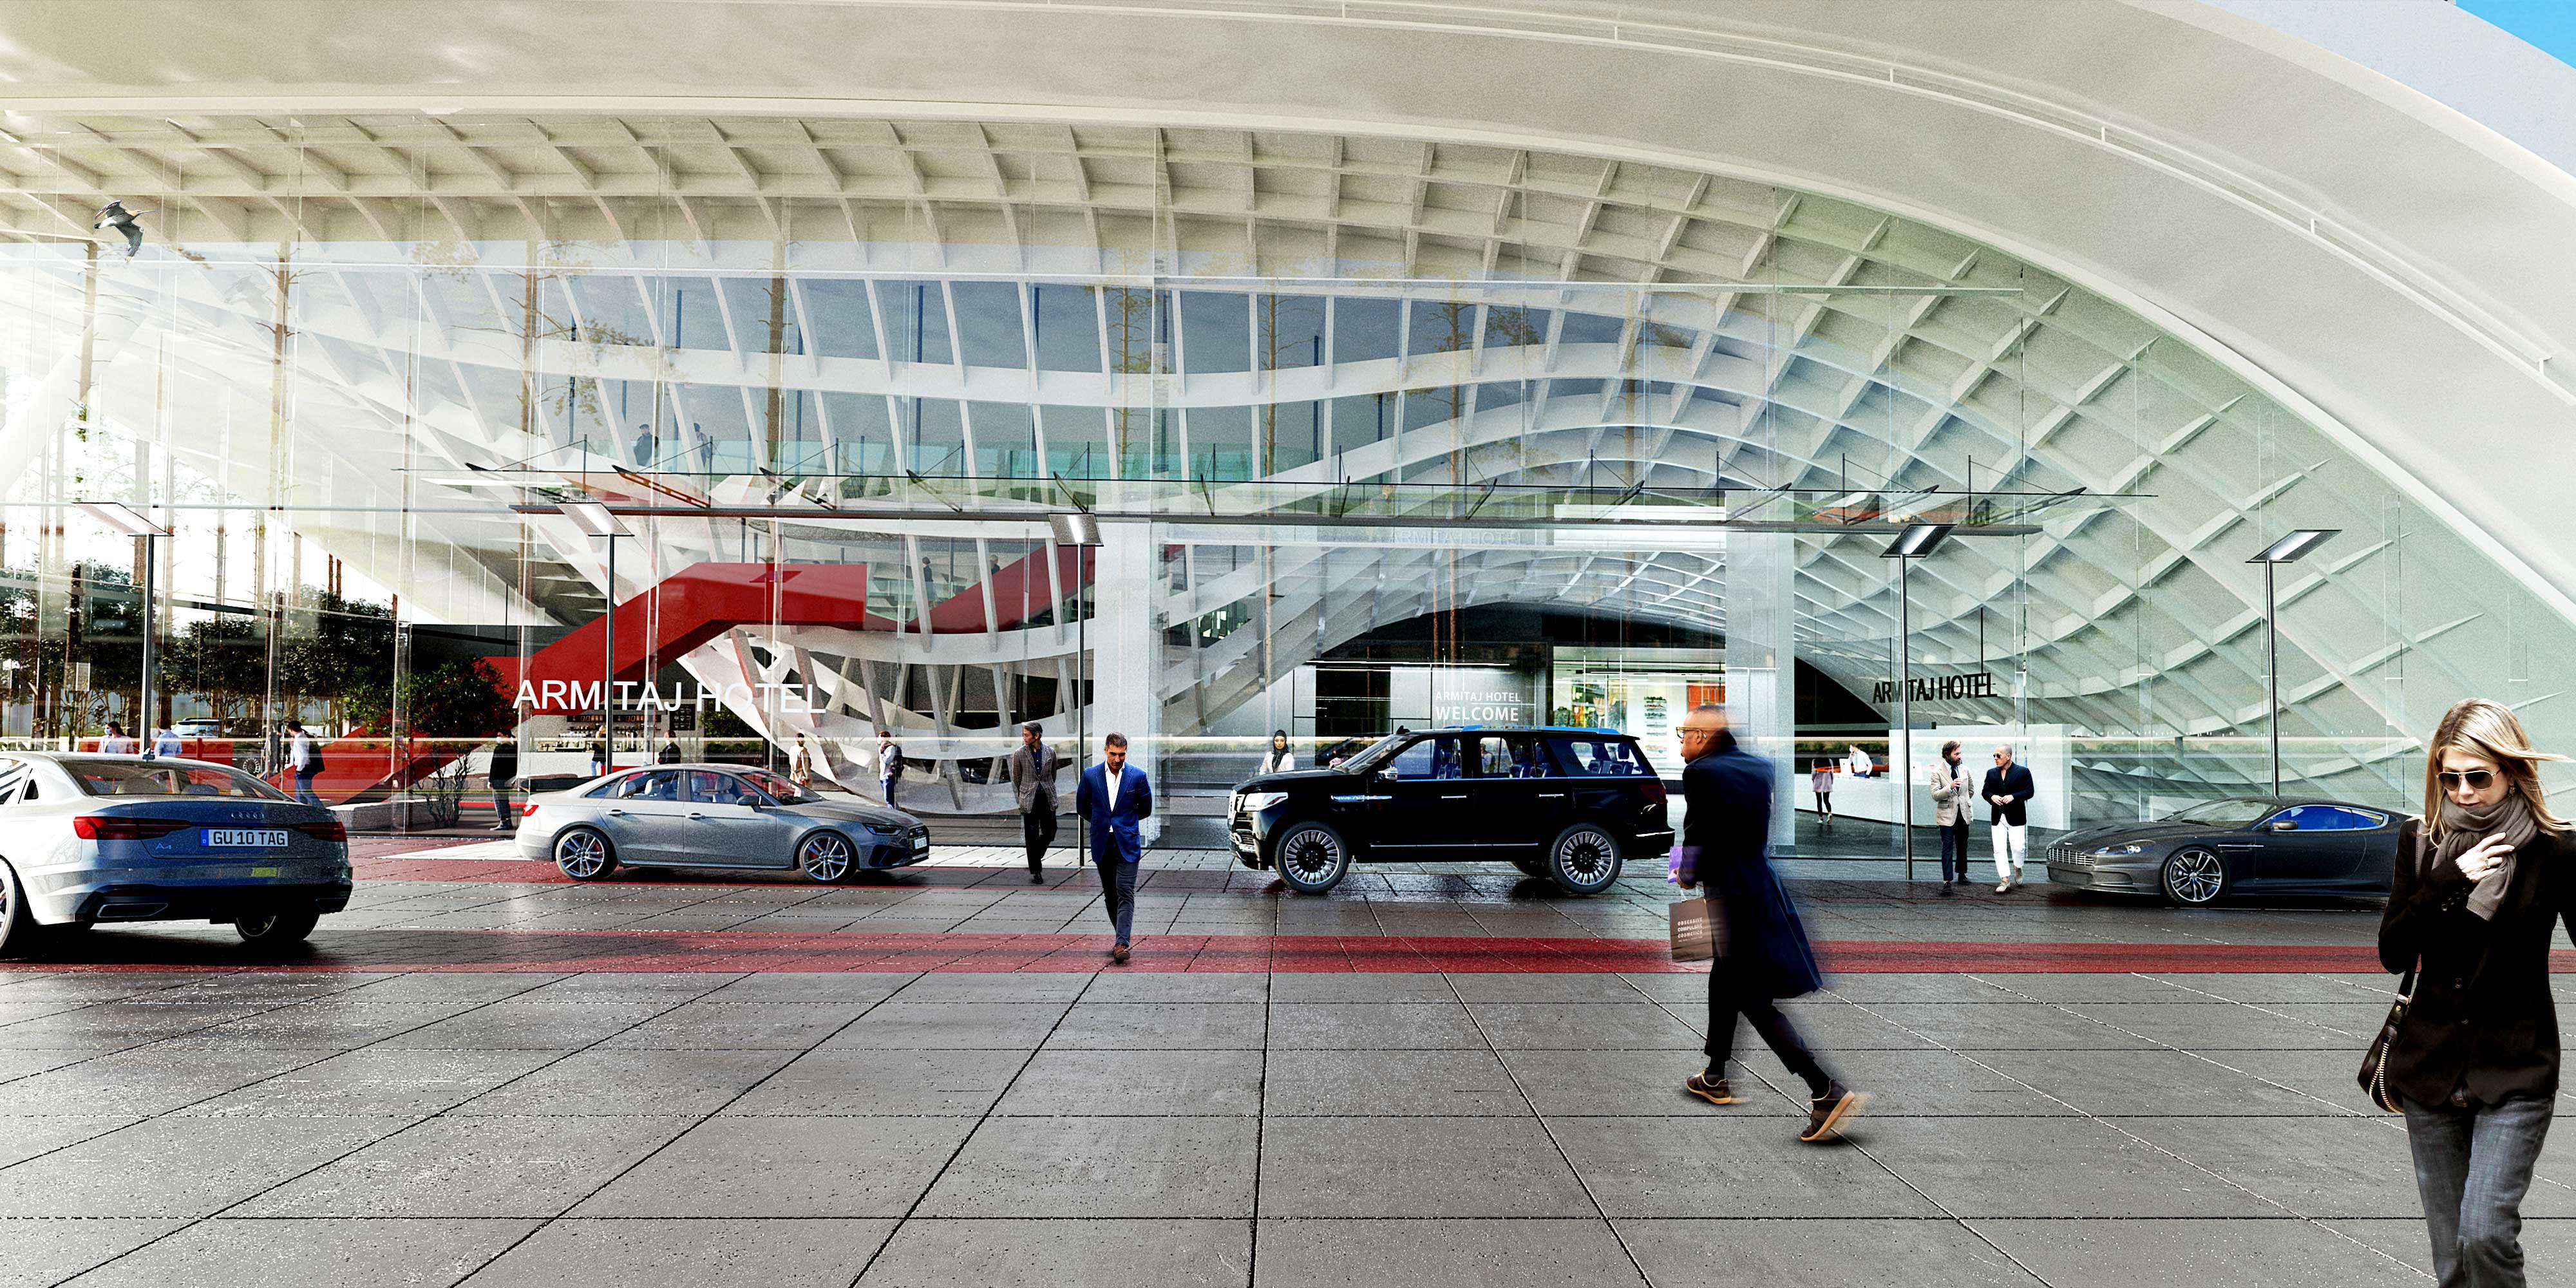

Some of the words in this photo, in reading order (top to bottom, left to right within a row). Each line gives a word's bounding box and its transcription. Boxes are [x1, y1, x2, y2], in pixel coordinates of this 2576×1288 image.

[1873, 677, 1935, 703] ARMTAJ
[1939, 672, 1998, 700] HOTEL
[697, 682, 826, 714] HOTEL
[1435, 691, 1481, 701] ARMITAJ
[1486, 692, 1520, 702] HOTEL
[1435, 706, 1519, 721] WELCOME
[213, 831, 232, 845] GU
[236, 831, 254, 845] 10
[258, 832, 285, 845] TAG
